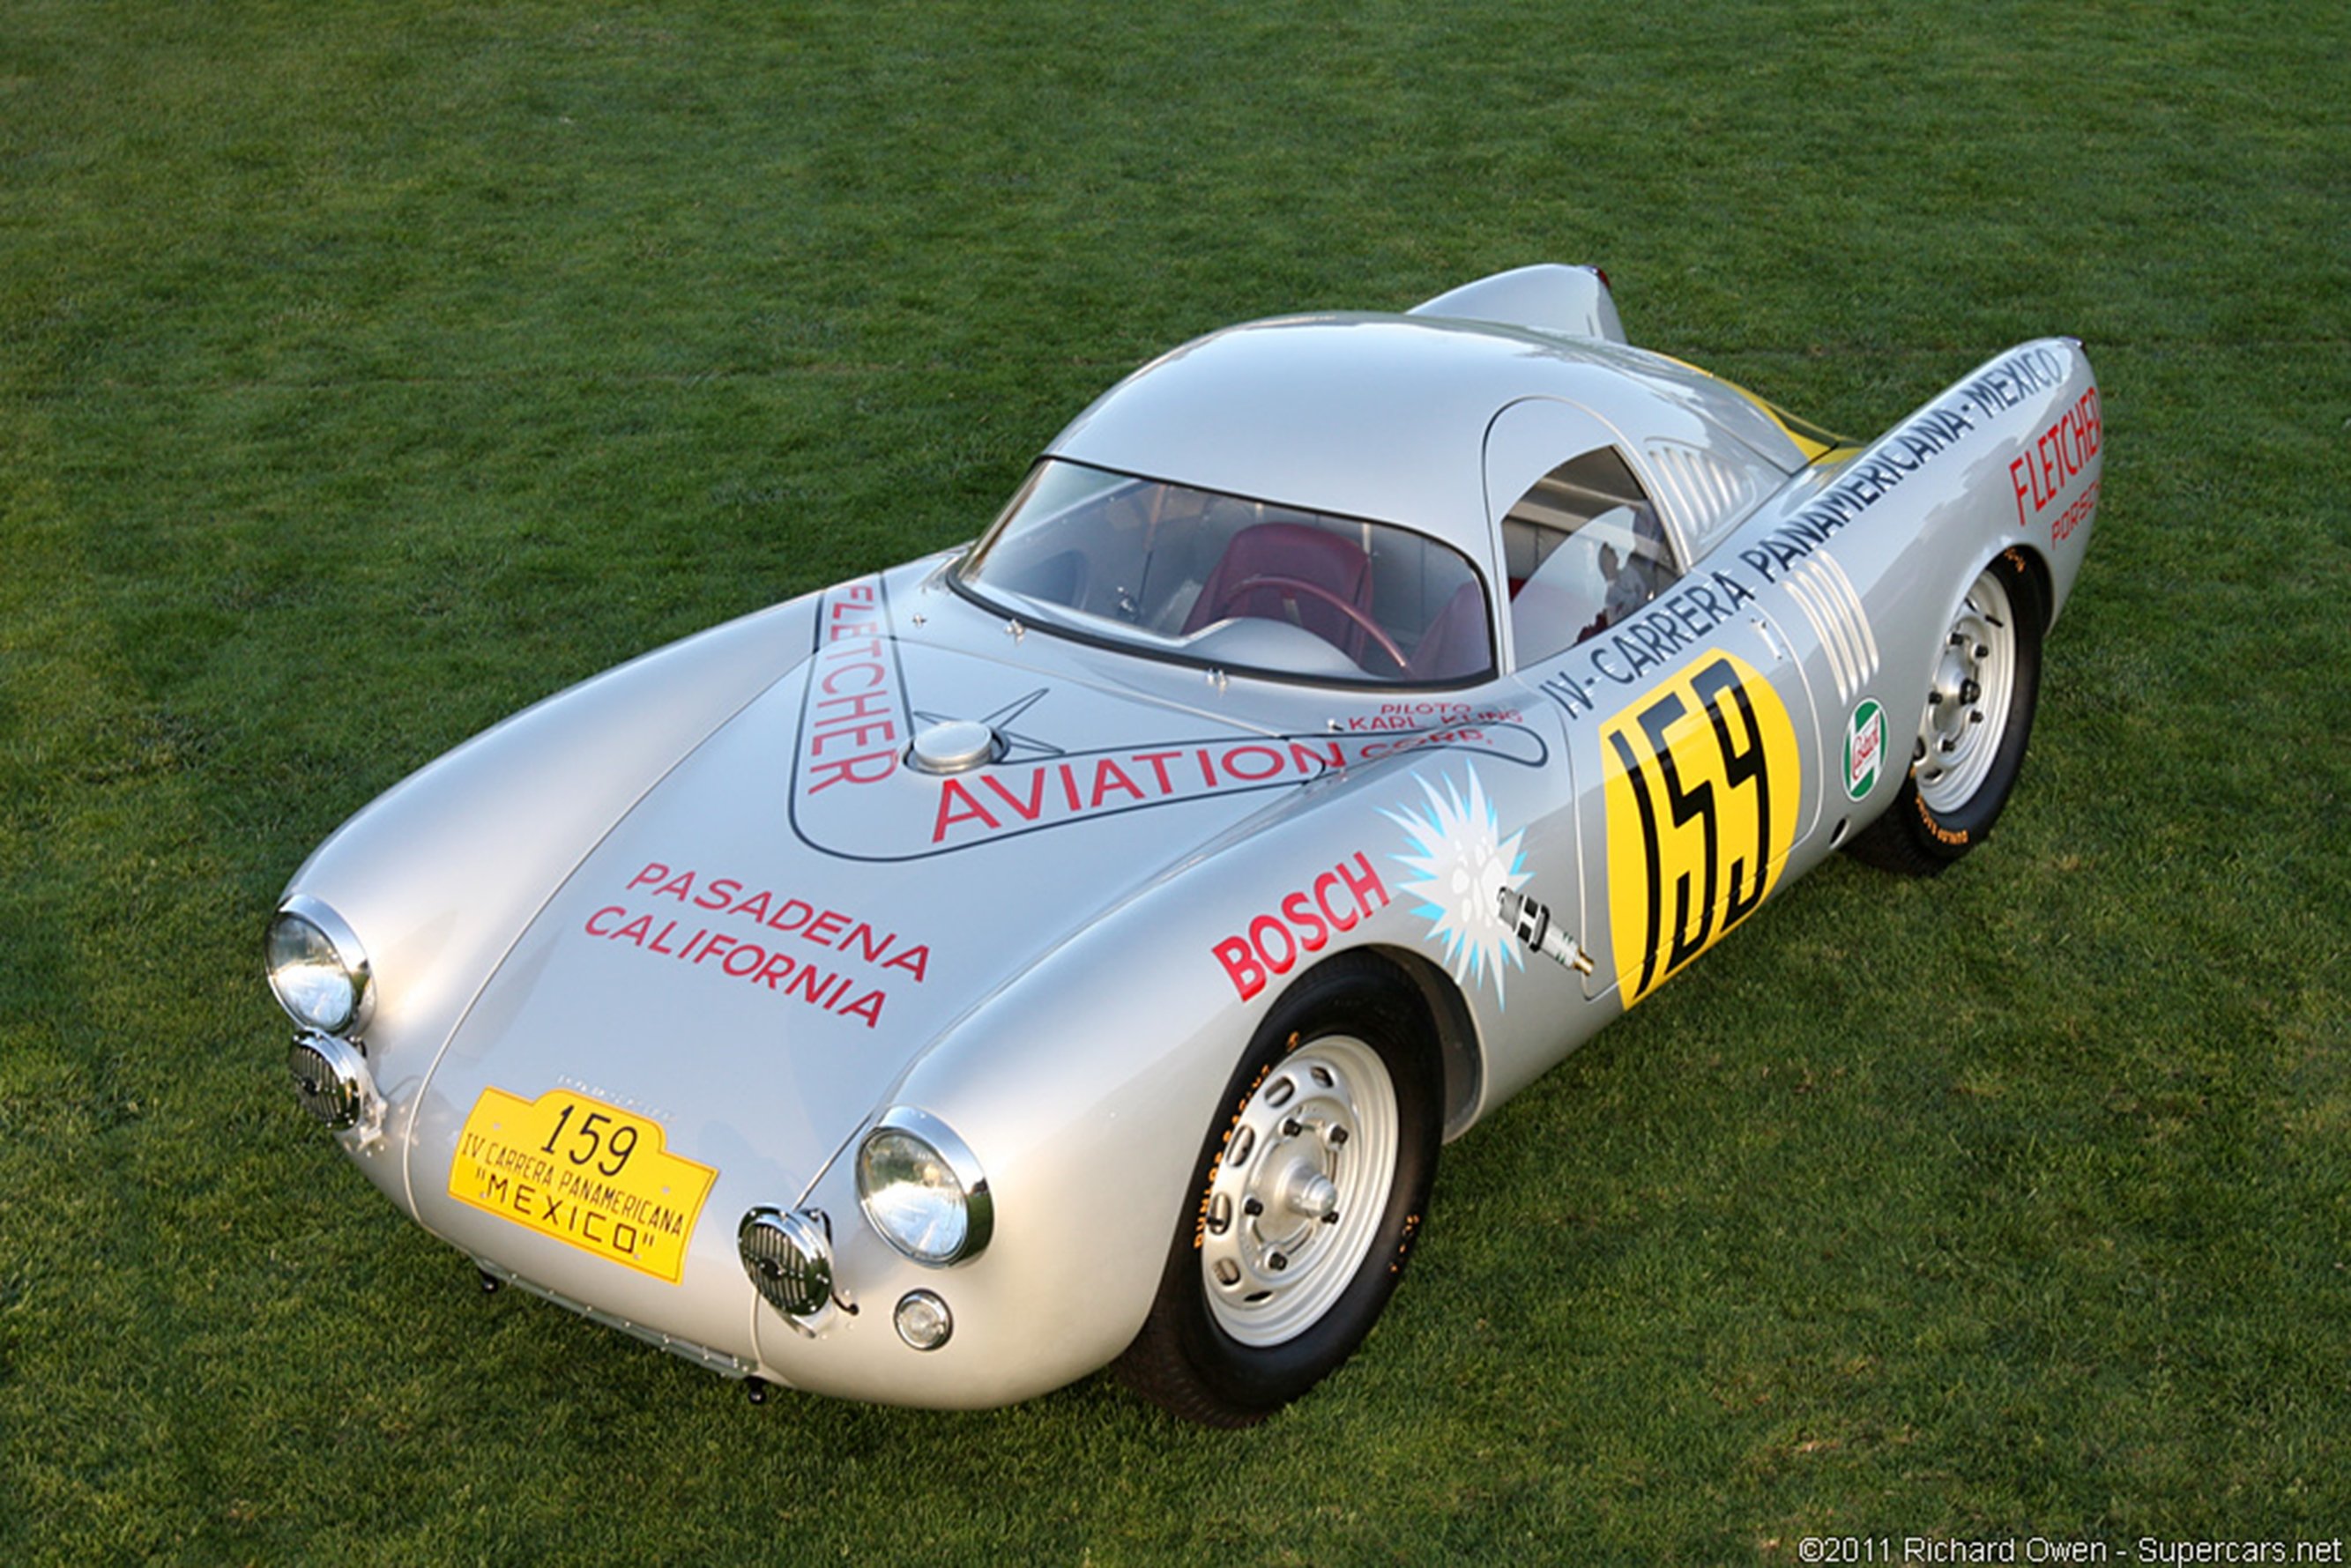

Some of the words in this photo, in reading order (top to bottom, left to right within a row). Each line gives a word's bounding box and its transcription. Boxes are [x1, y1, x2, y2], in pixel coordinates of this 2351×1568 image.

[807, 585, 897, 794] FLETCHER
[1348, 717, 1427, 731] KARL
[1380, 702, 1471, 715] PILOTO
[932, 743, 1346, 843] AVIATION
[1609, 658, 1770, 1000] 159
[584, 906, 887, 1029] CALIFORNIA
[626, 862, 931, 983] PASADENA
[1211, 851, 1391, 1002] BOSCH
[462, 1133, 485, 1158] IV
[485, 1141, 554, 1187] CARRERA
[558, 1169, 684, 1237] PANAMERICANA
[540, 1104, 637, 1177] 159
